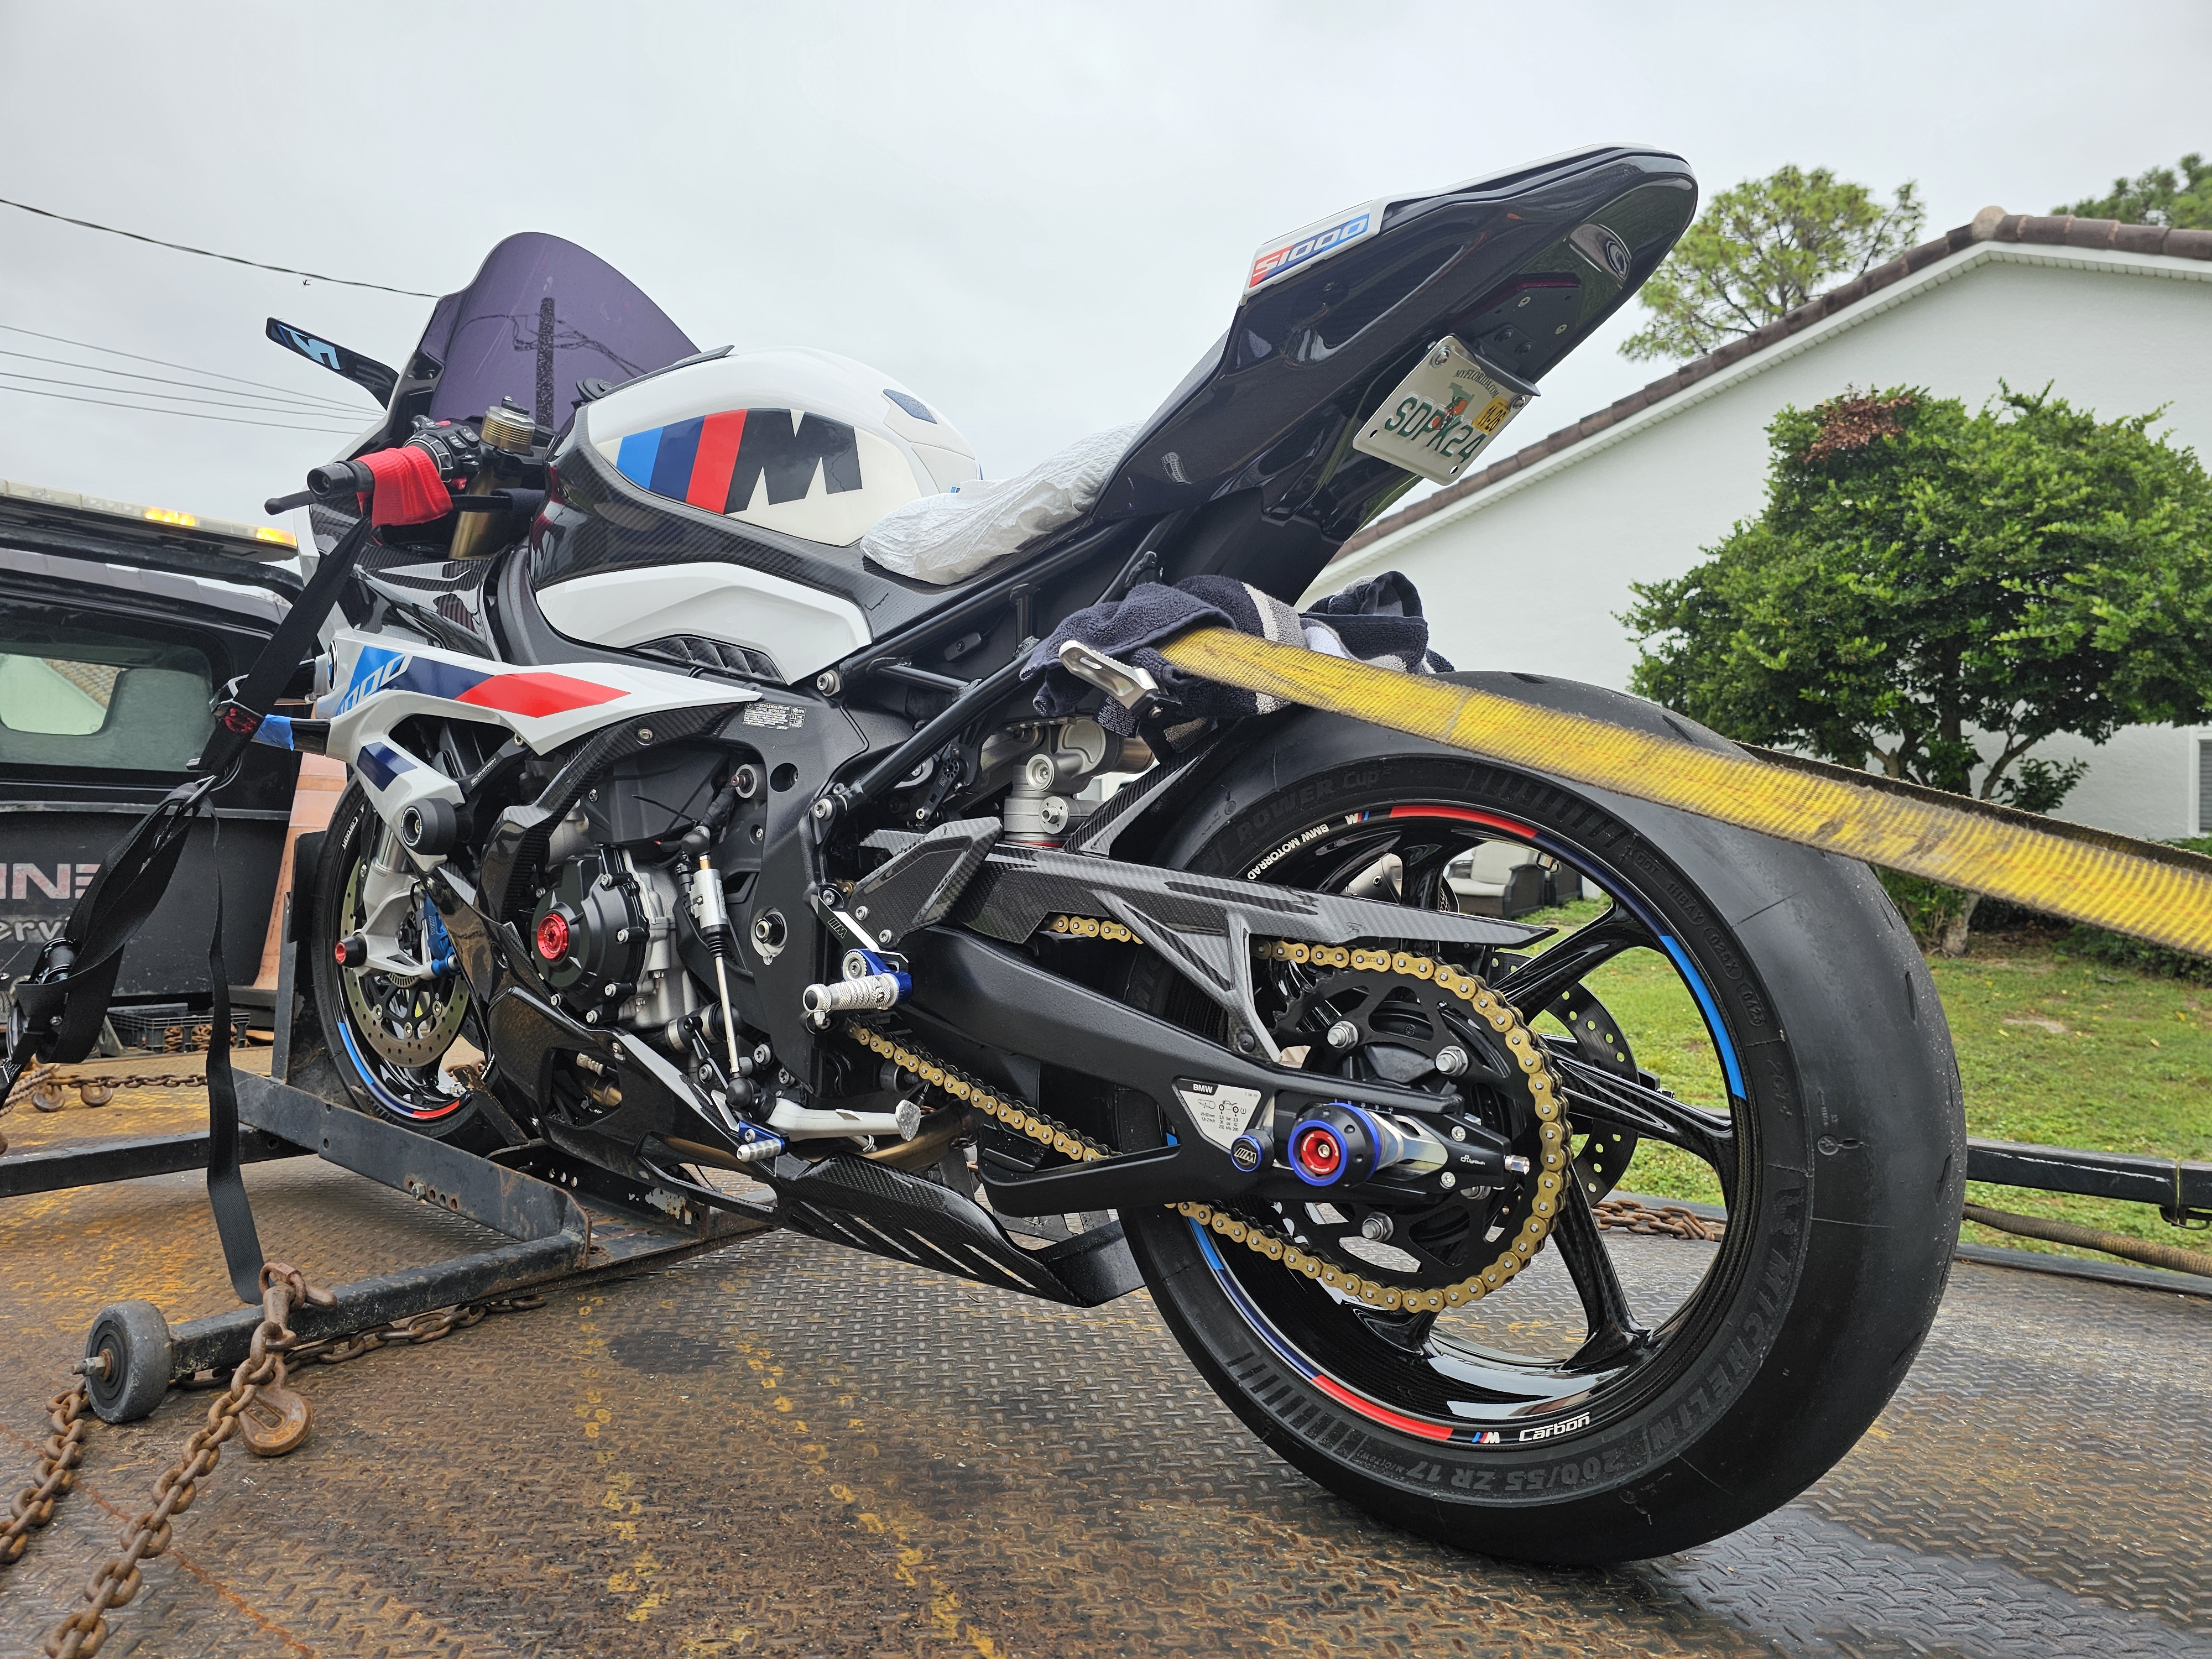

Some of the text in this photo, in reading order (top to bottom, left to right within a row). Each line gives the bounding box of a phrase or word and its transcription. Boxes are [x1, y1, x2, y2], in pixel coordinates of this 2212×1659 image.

[1251, 217, 1368, 278] S1000
[1453, 369, 1500, 399] MYFLORIDA.COM
[724, 408, 863, 515] M
[1237, 779, 1334, 843] POWER
[341, 817, 358, 851] Carbon
[1247, 823, 1329, 880] BMW MOTORRAD
[1637, 853, 1660, 874] DOT
[1193, 1083, 1213, 1093] BMW
[1519, 1411, 1590, 1442] Carbon
[1407, 1460, 1442, 1481] 17
[1451, 1468, 1495, 1490] ZR
[1504, 1451, 1620, 1490] 200/55
